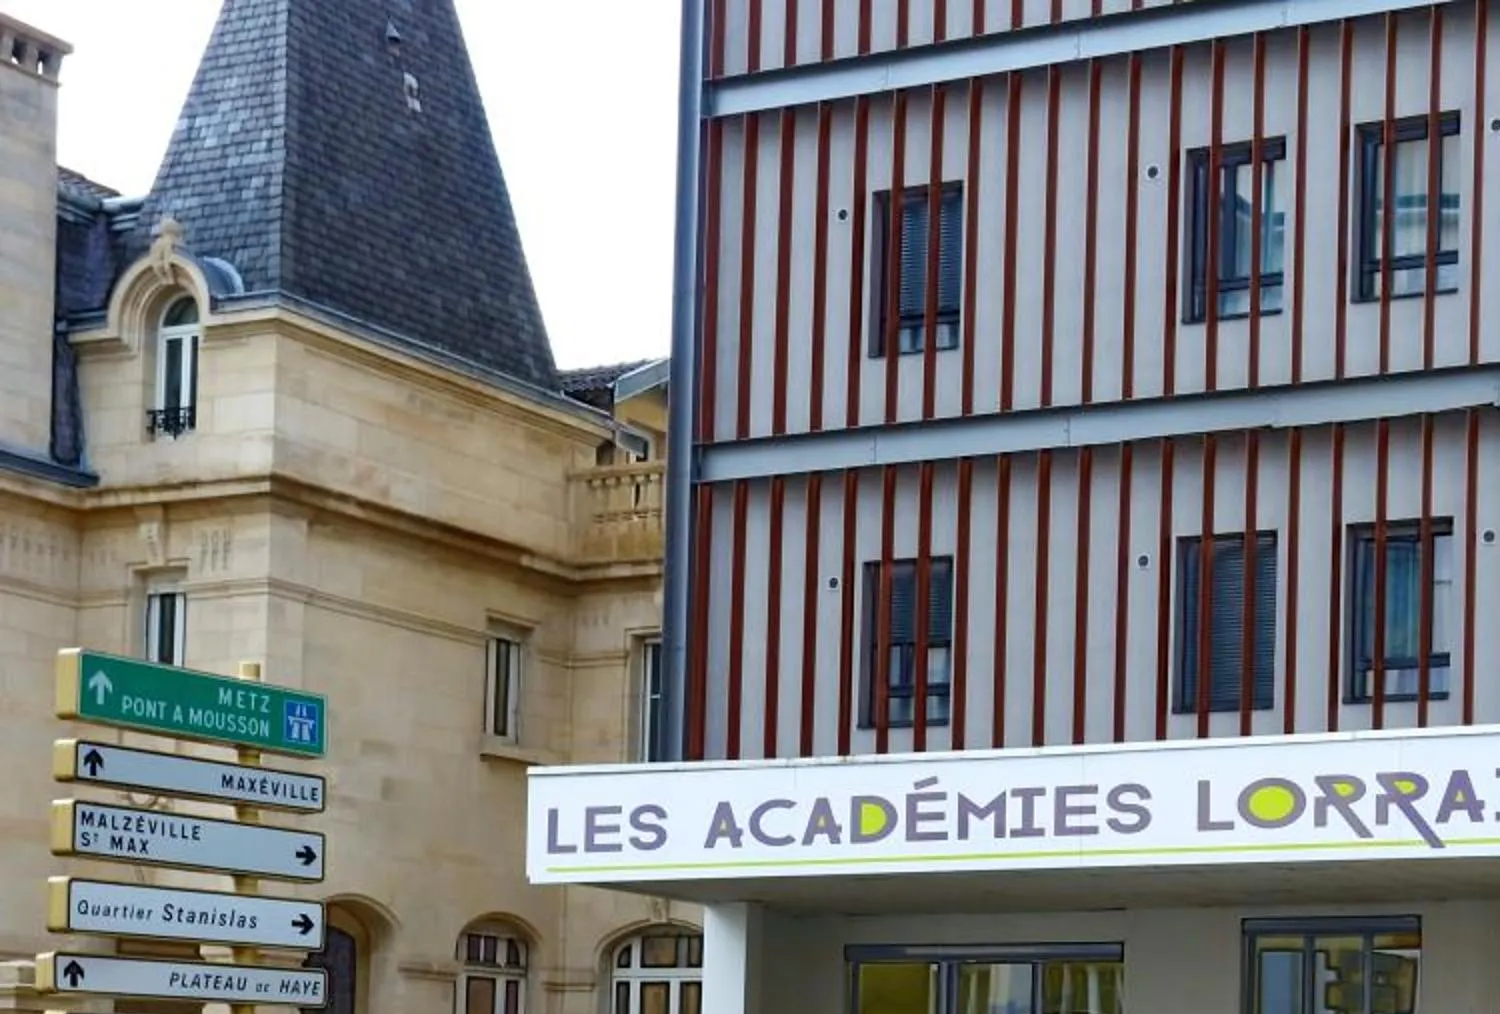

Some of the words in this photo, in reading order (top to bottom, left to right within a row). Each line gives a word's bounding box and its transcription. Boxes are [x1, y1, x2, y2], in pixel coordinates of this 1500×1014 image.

[218, 686, 271, 713] METZ
[121, 695, 168, 721] PONT
[172, 704, 184, 724] A
[188, 706, 270, 738] MOUSSON
[221, 773, 319, 802] MAXÉVILLE
[80, 810, 201, 841] MALZÉVILLE
[547, 803, 668, 855] LES
[704, 775, 1153, 849] ACADÉMIES
[110, 836, 150, 855] MAX
[77, 900, 153, 921] Quartier
[162, 903, 258, 930] Stanislas
[169, 972, 247, 991] PLATEAU
[279, 979, 321, 996] HAYE
